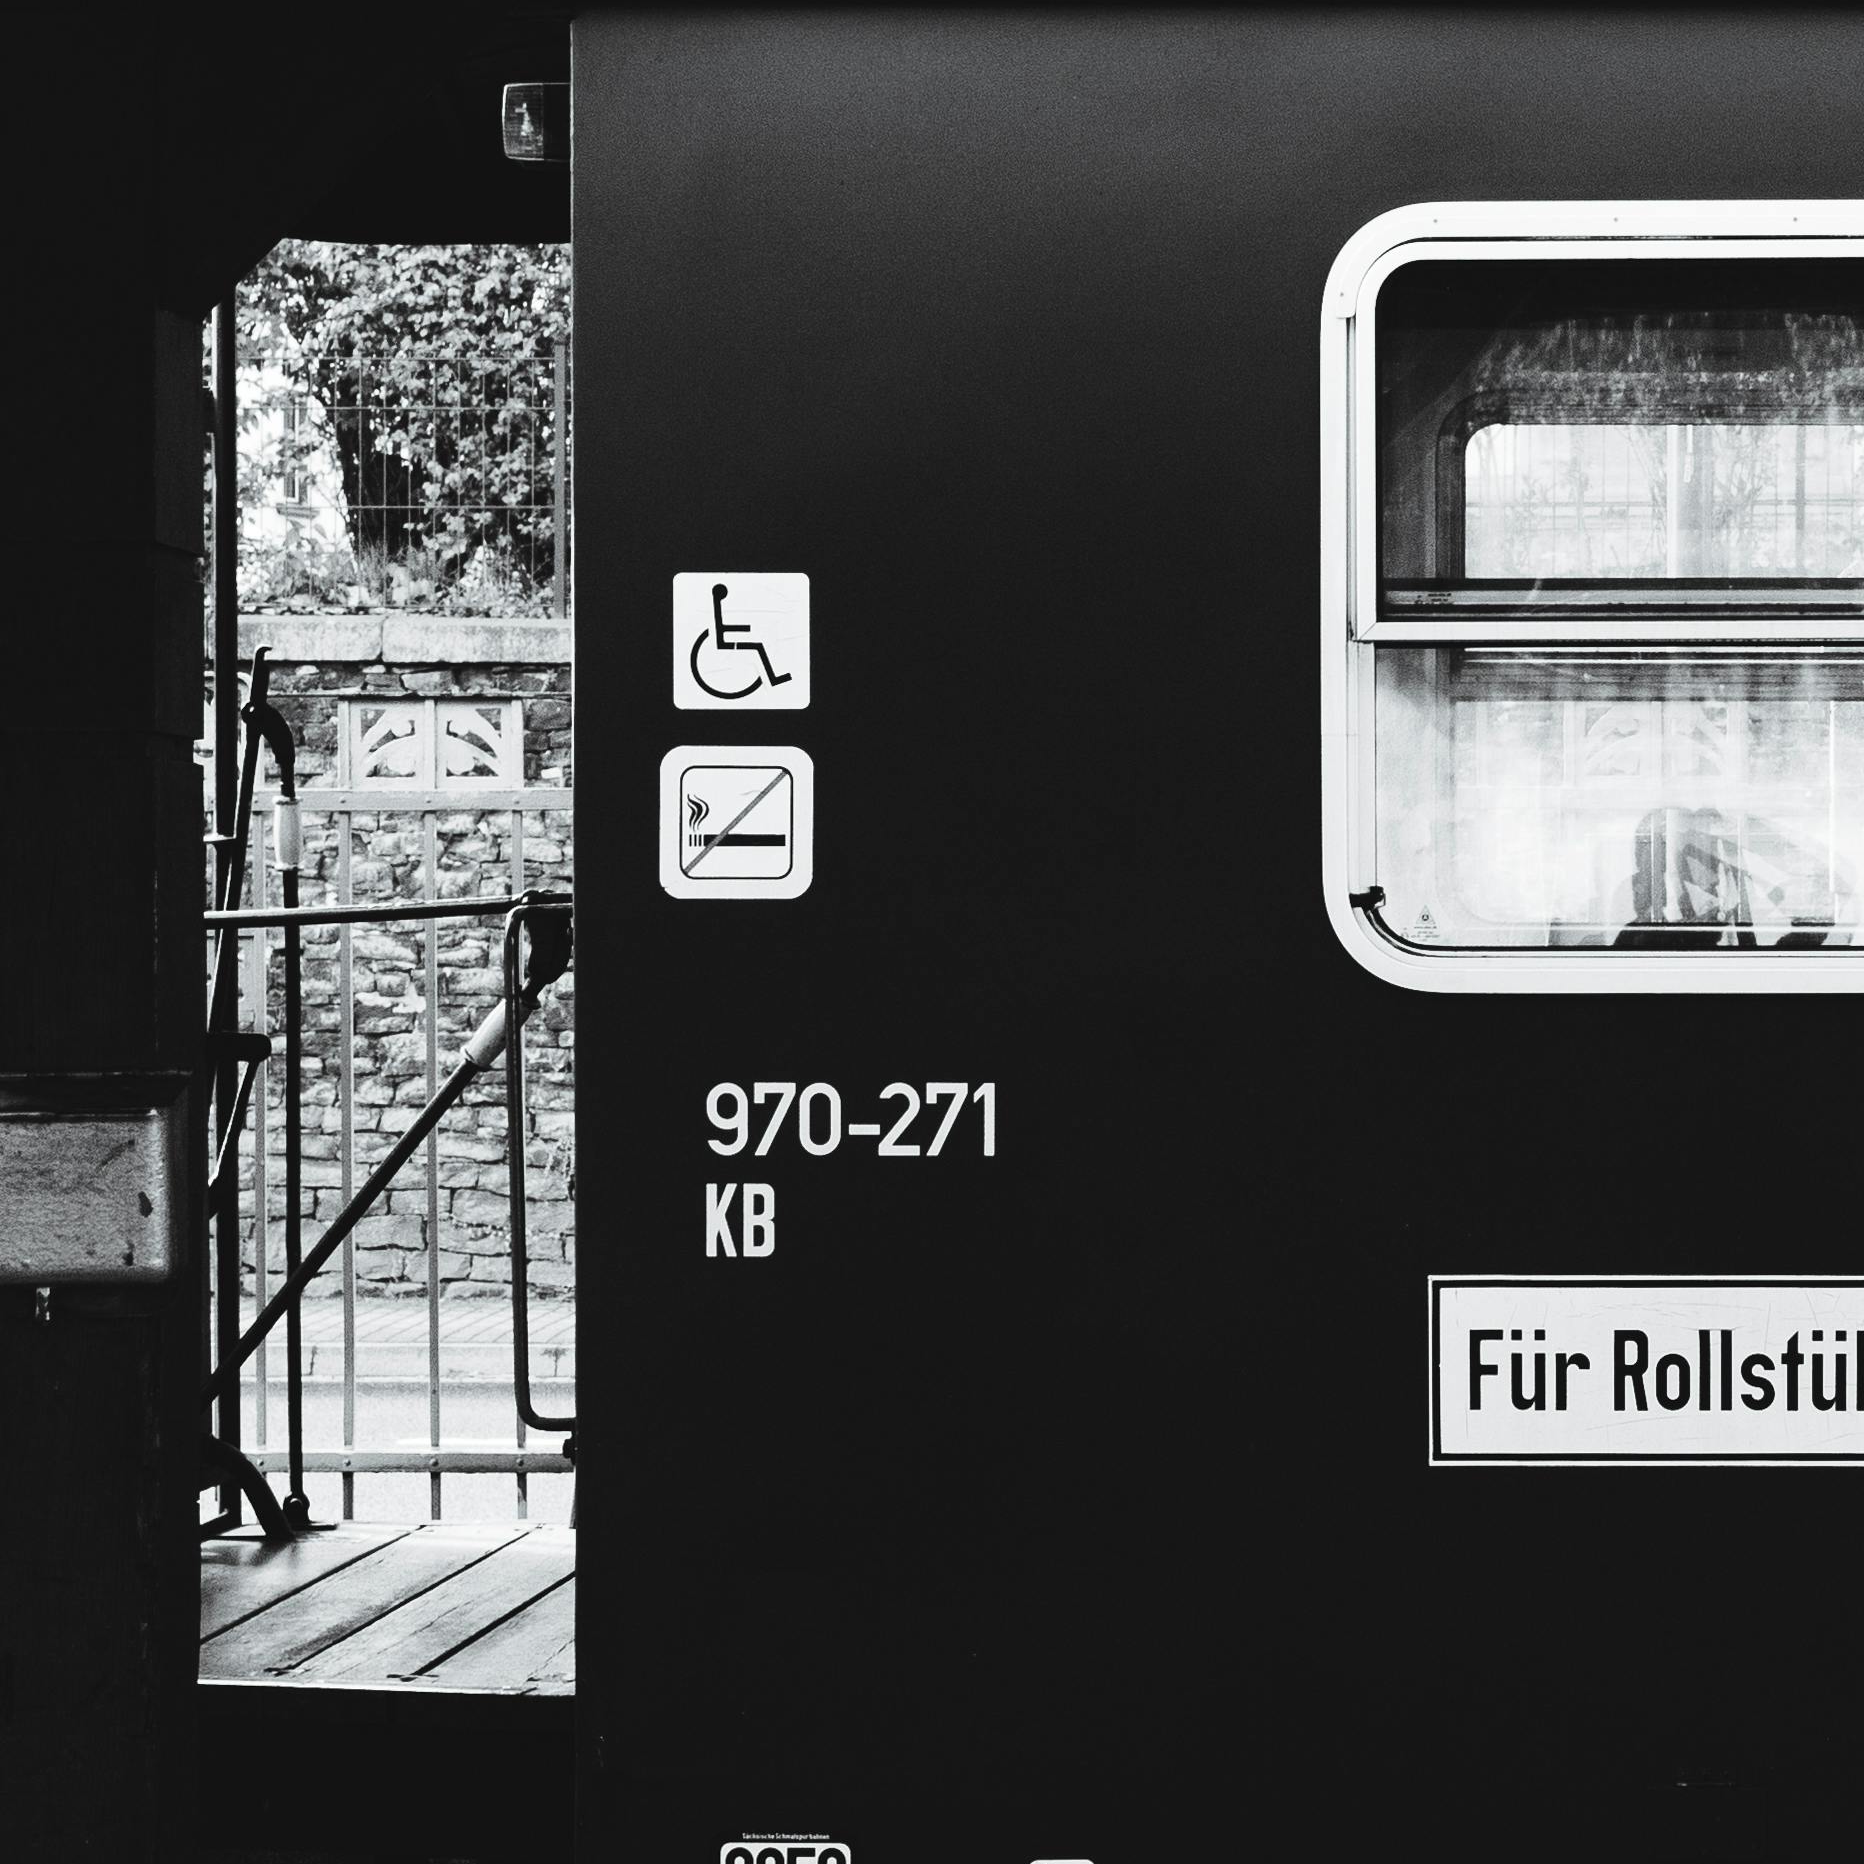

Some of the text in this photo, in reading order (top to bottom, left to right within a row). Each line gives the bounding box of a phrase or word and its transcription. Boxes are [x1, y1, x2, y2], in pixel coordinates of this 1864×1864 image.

[706, 1082, 996, 1157] 970-271
[705, 1182, 776, 1258] KB
[1469, 1329, 1591, 1411] Für
